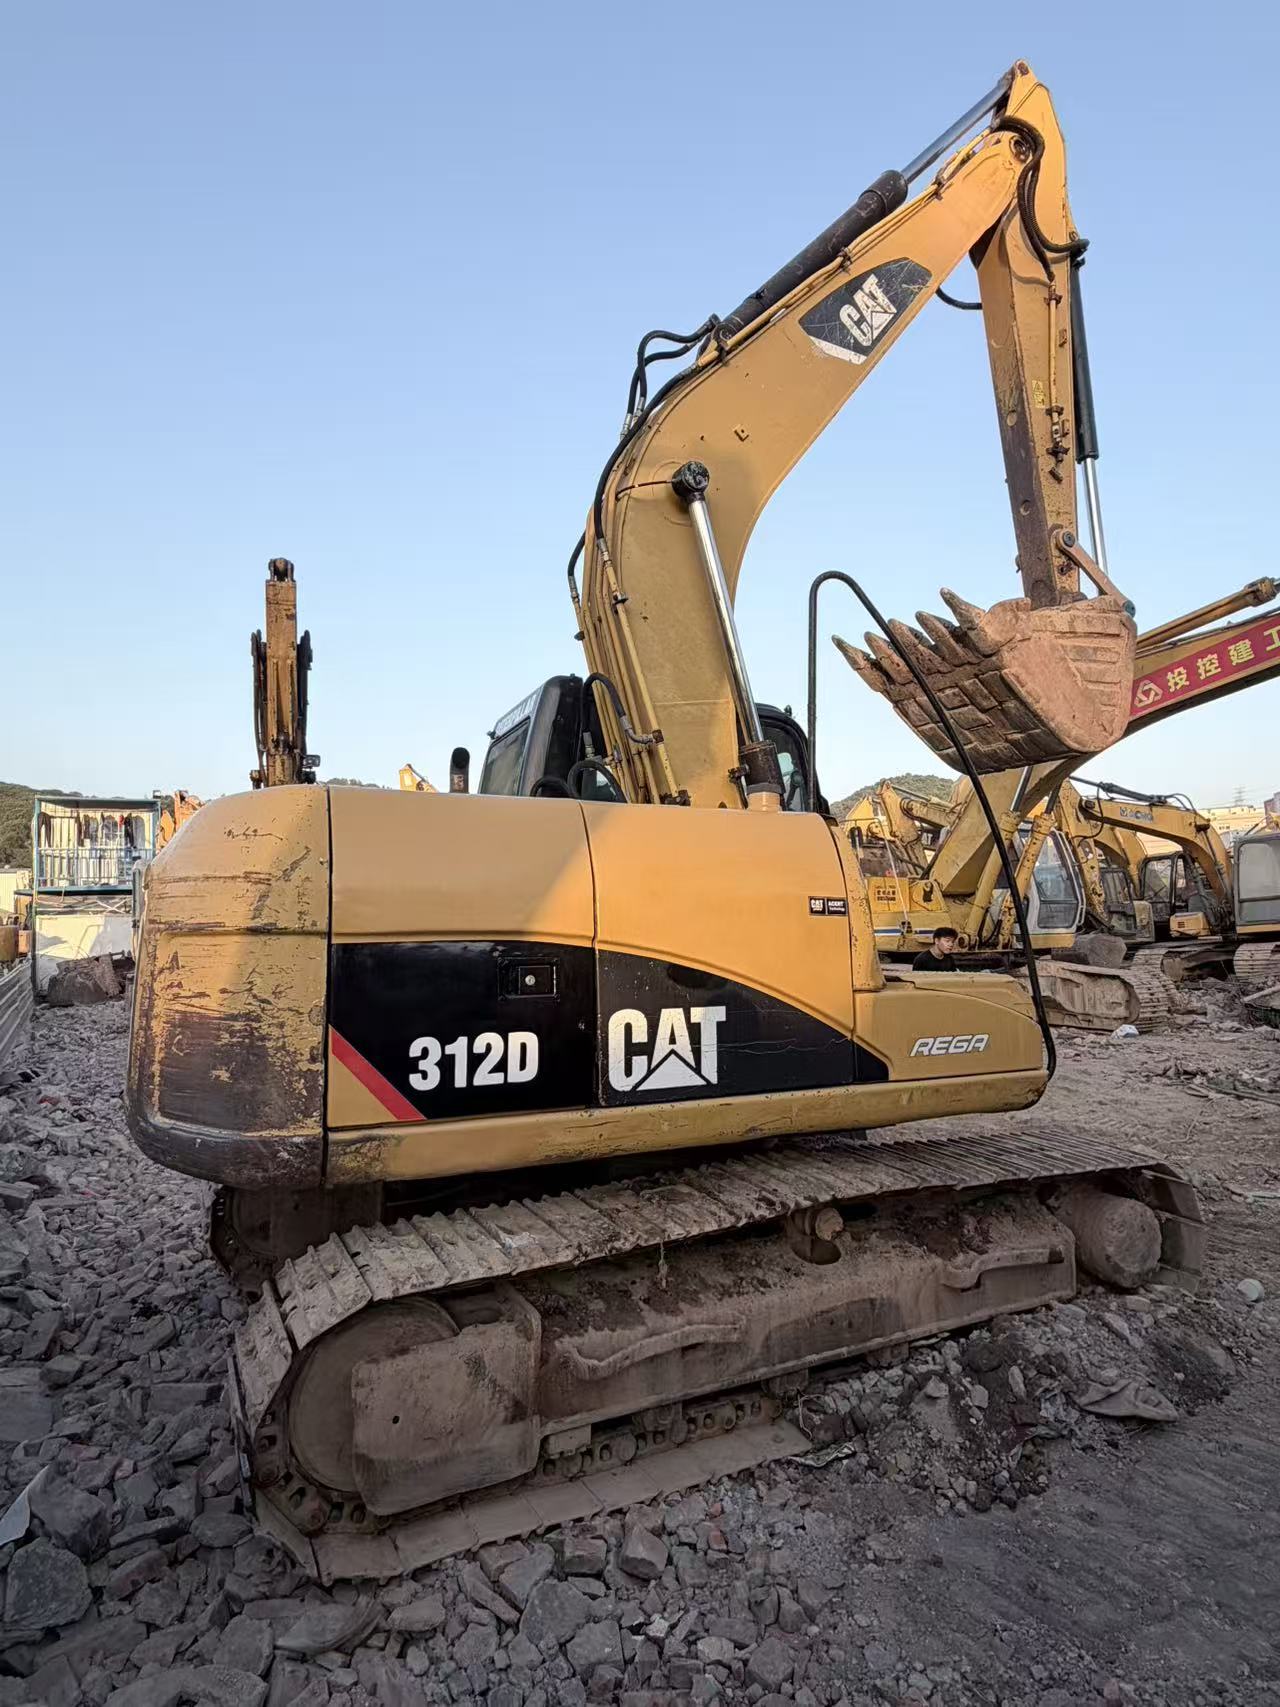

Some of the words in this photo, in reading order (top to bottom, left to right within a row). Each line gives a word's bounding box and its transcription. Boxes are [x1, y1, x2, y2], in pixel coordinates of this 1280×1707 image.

[839, 273, 898, 347] CAT
[921, 832, 933, 846] AT
[408, 1031, 540, 1092] 312D
[607, 1005, 727, 1093] CAT
[909, 1033, 989, 1057] REGA
